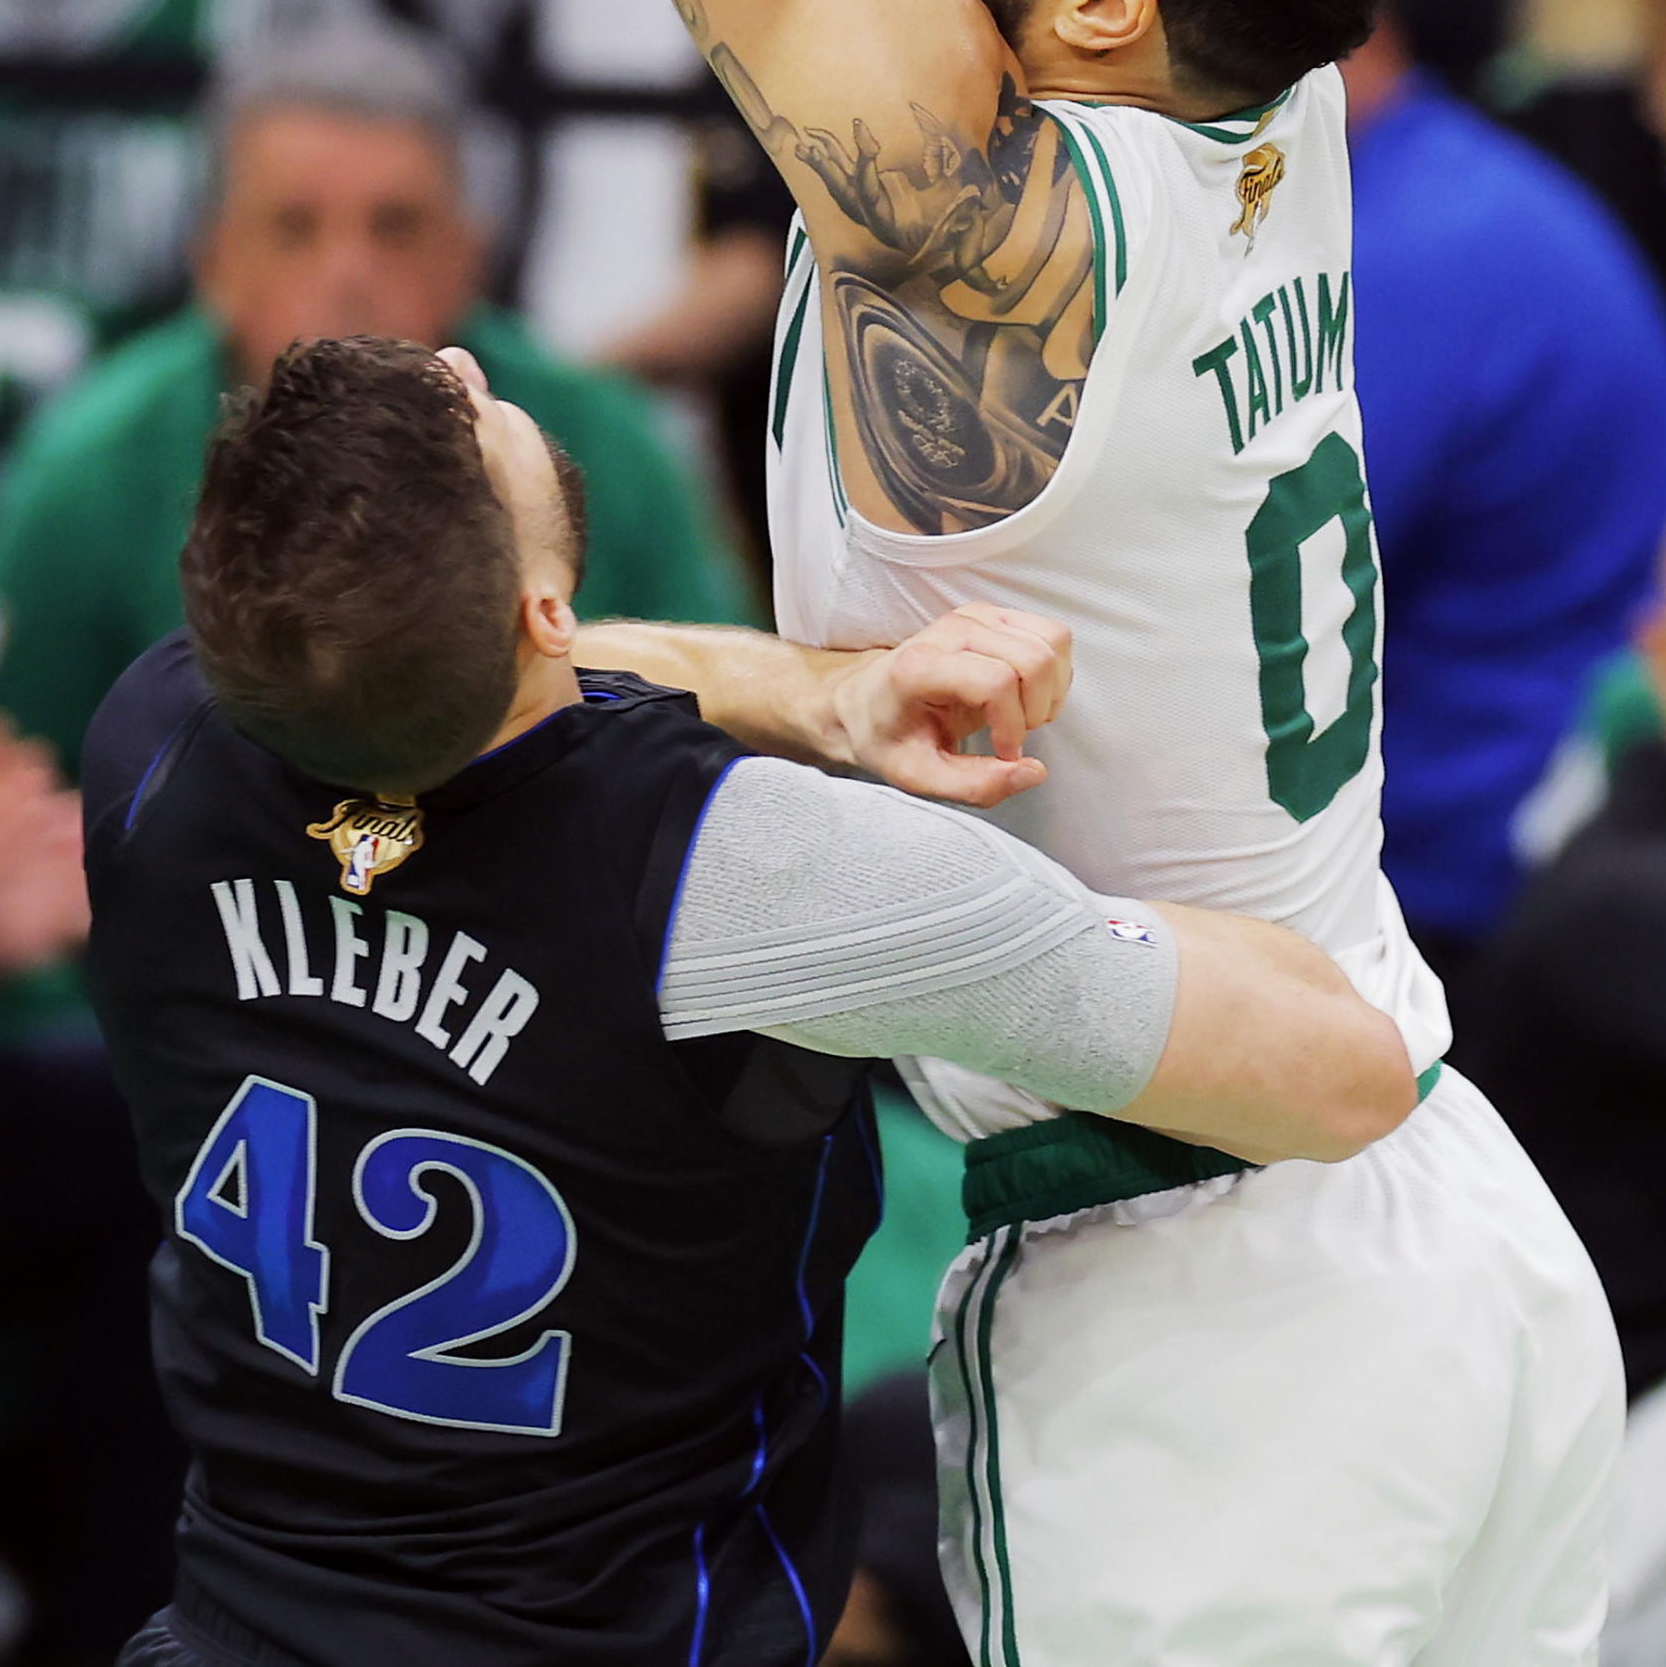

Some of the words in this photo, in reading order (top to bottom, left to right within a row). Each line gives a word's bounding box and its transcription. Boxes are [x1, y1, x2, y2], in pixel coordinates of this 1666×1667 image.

[1192, 270, 1353, 456] TATUM
[1245, 430, 1379, 825] 0
[210, 877, 540, 1086] KLEBER
[176, 1074, 578, 1438] 42
